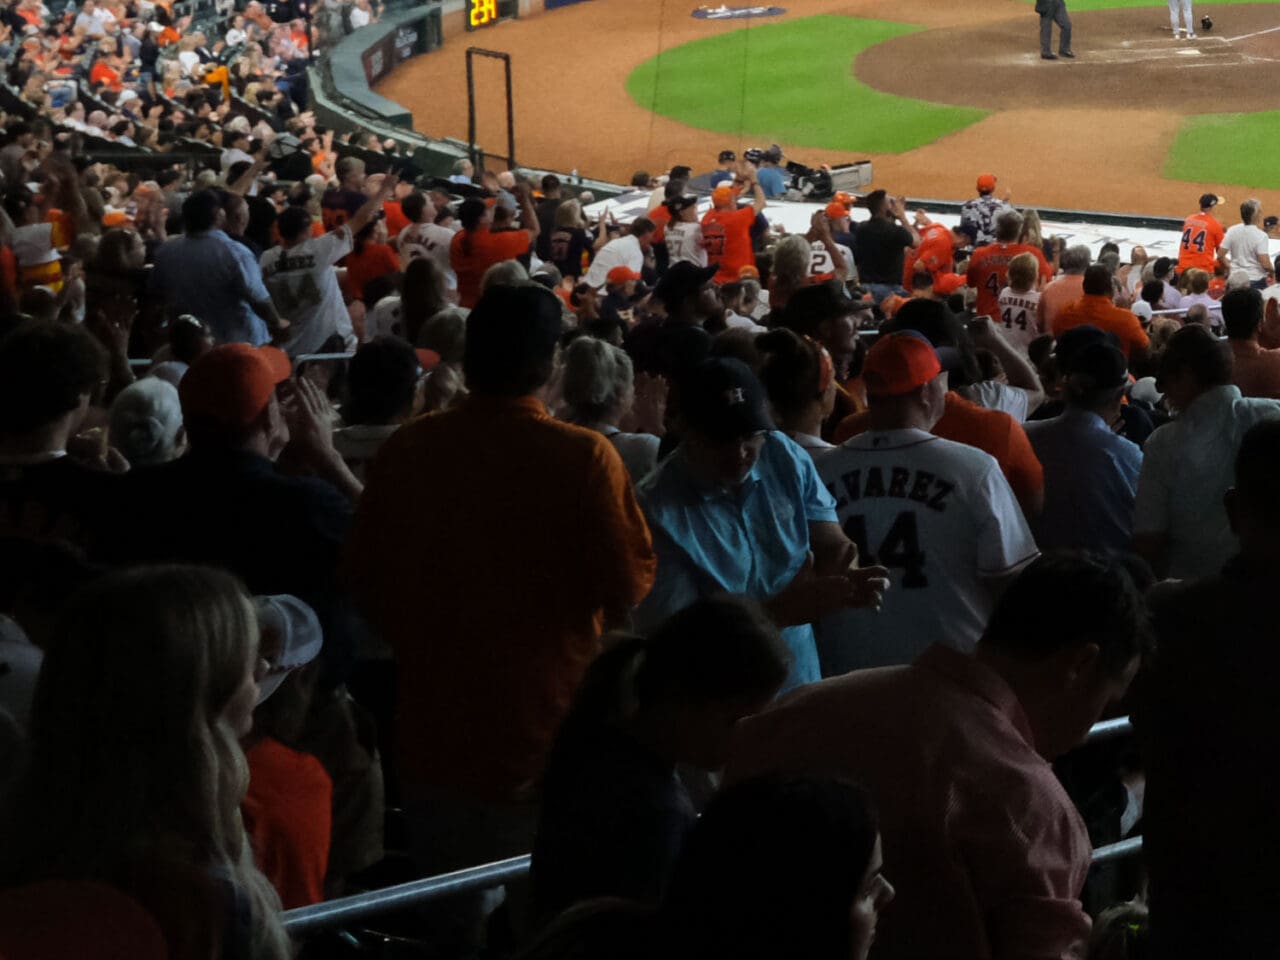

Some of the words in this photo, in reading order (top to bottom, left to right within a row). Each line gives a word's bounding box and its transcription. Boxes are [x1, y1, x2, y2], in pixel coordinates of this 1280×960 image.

[1181, 228, 1206, 252] 44
[811, 254, 826, 274] 2
[1002, 307, 1027, 330] 44
[829, 465, 956, 512] LVAREZ
